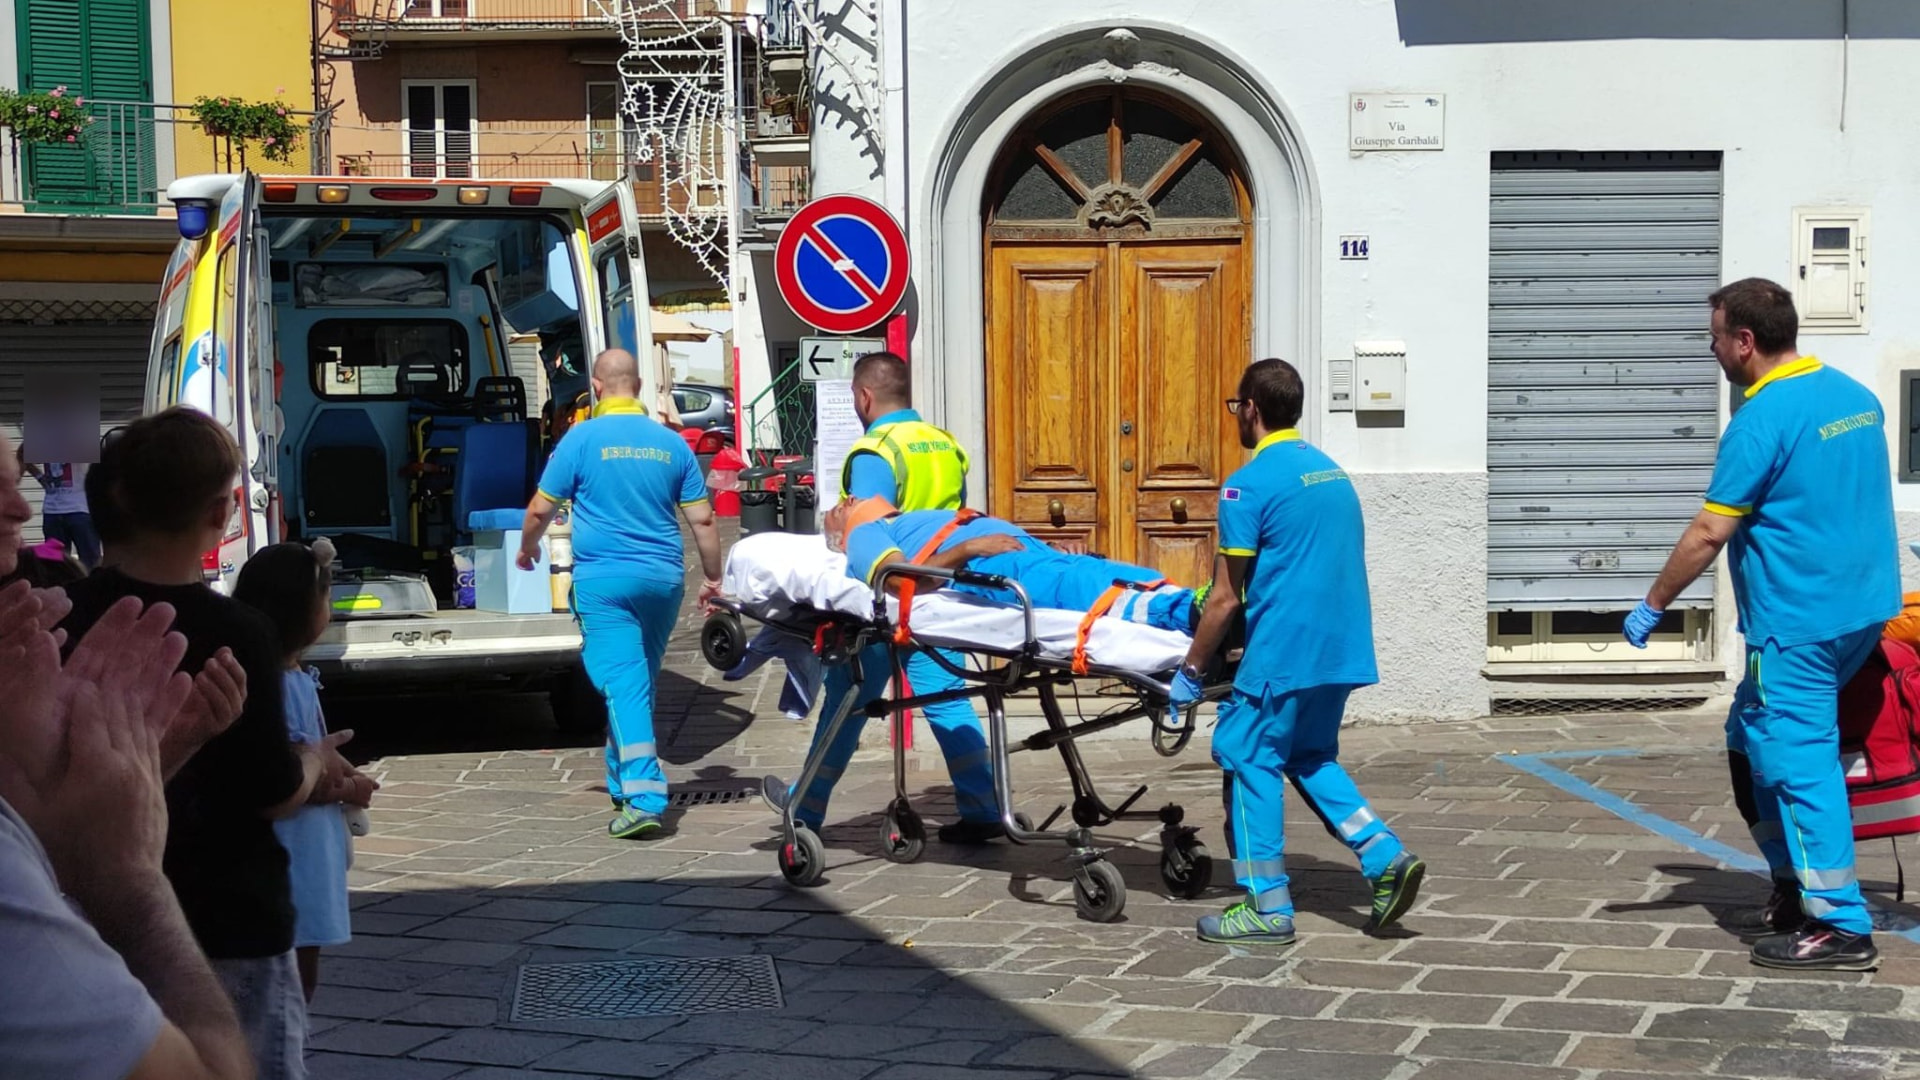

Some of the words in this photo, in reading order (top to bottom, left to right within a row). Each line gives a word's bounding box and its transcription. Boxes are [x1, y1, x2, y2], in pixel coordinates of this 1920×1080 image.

[1389, 121, 1405, 131] Via
[1354, 136, 1395, 147] Giuseppe
[1398, 136, 1439, 145] Garibaldi
[1341, 240, 1368, 256] 114
[842, 350, 853, 359] Su
